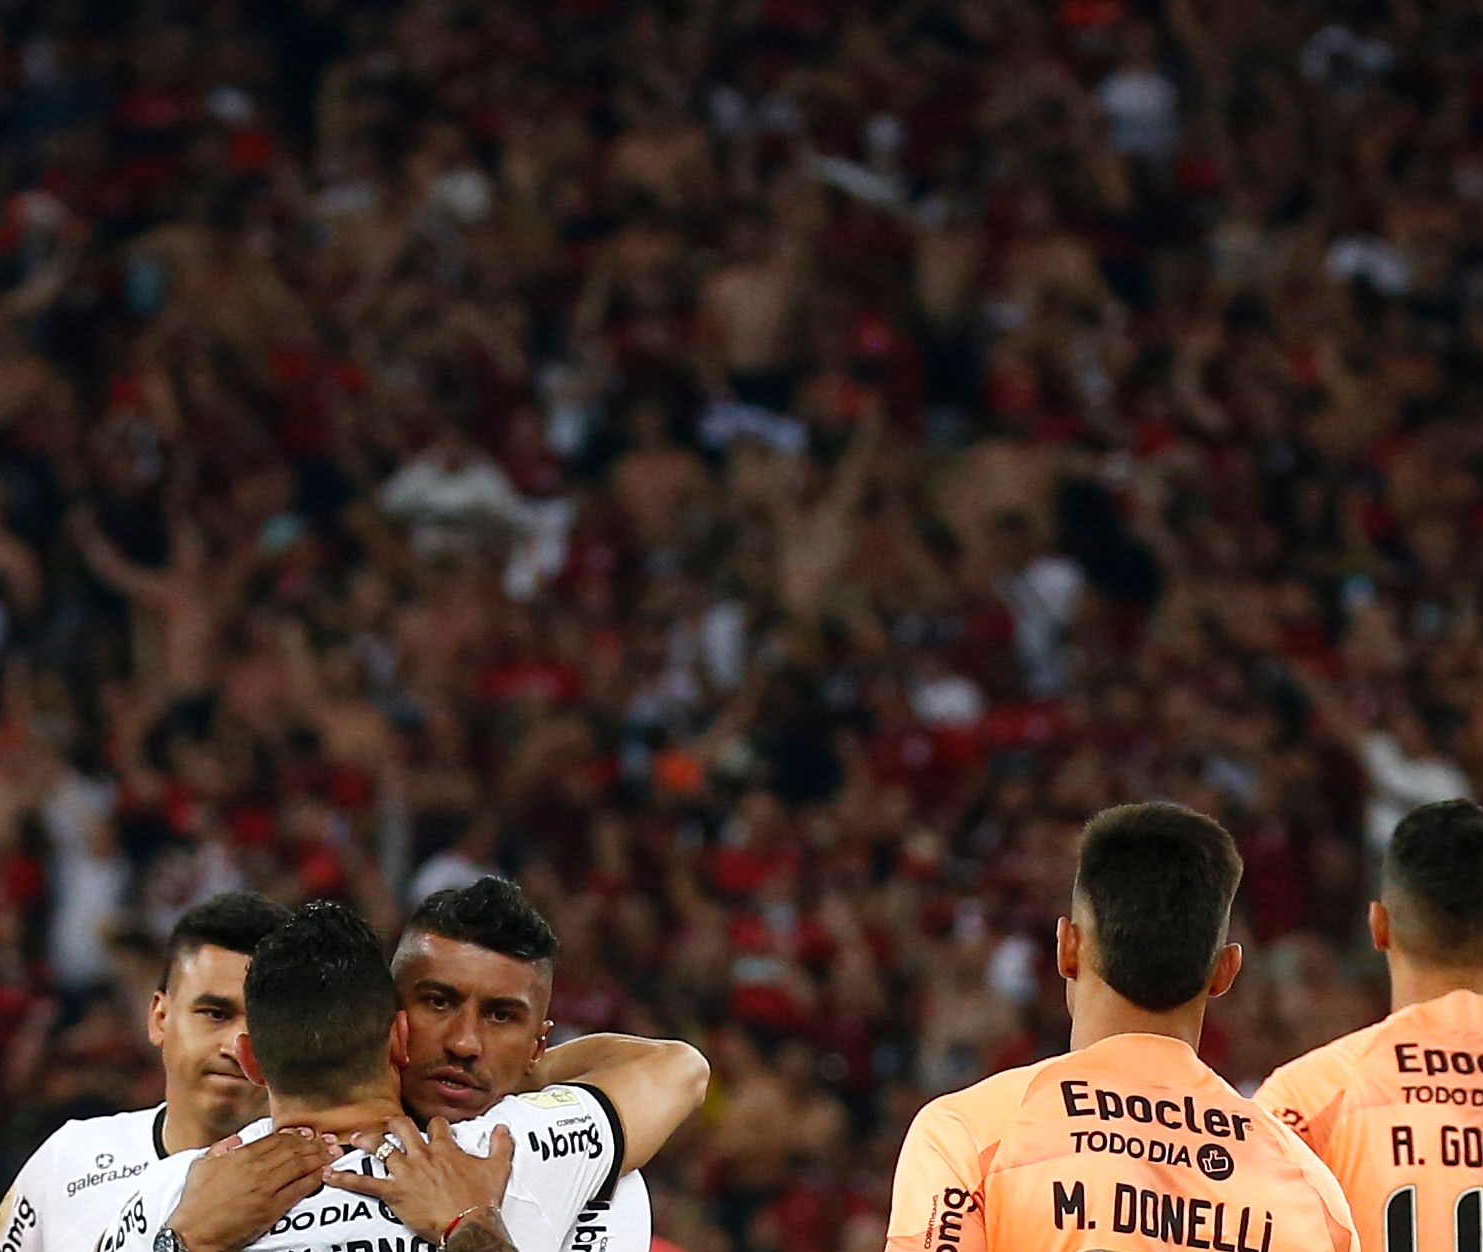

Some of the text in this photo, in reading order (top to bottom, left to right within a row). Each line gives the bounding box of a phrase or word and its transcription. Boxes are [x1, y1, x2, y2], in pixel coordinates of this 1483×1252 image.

[1060, 1080, 1252, 1141] Epocler
[1401, 1085, 1467, 1106] TODO
[549, 1123, 603, 1160] bmg
[1070, 1131, 1193, 1168] TODO DIA
[320, 1201, 373, 1227] DIA
[1053, 1180, 1096, 1231] M.
